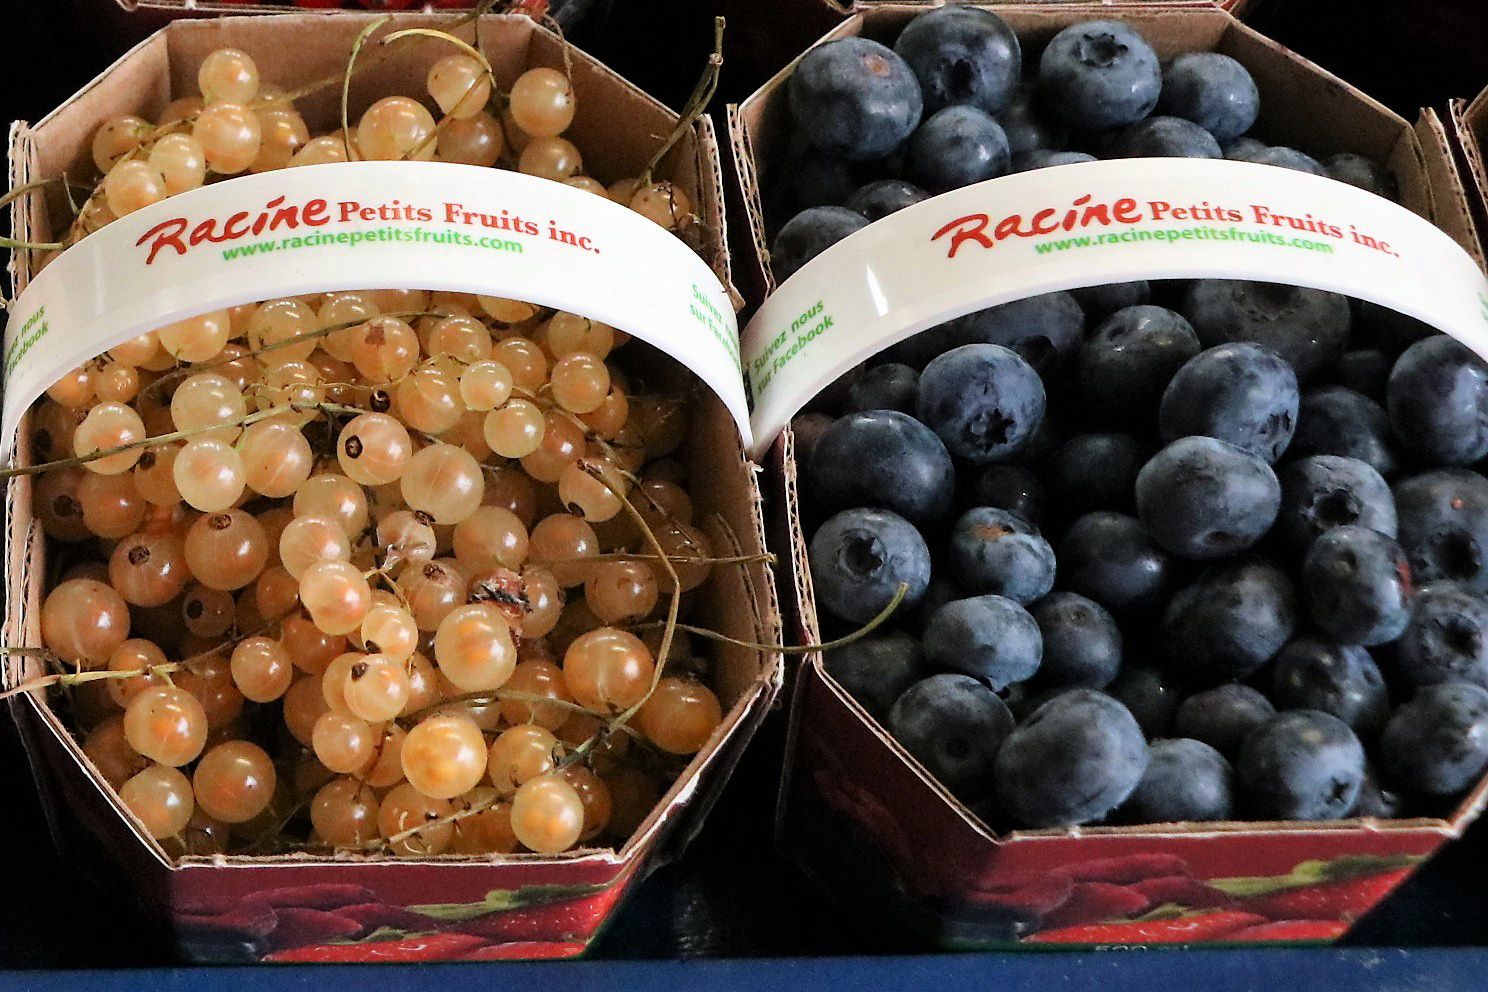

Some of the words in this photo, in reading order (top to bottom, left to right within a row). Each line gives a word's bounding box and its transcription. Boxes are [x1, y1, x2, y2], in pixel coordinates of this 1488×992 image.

[136, 195, 332, 266] Racine
[337, 200, 434, 224] Petits
[444, 202, 541, 236] Fruits
[548, 219, 601, 254] inc.
[221, 227, 525, 262] www.racinepetitsfruits.com
[930, 193, 1145, 259] Racine
[1147, 200, 1245, 224] Petits
[1252, 204, 1345, 240] Fruits
[1351, 224, 1402, 258] inc.
[1034, 225, 1336, 256] www.racinepetitsfruits.com
[755, 330, 788, 373] Suivez
[791, 300, 824, 334] nous
[773, 315, 835, 374] Facebook
